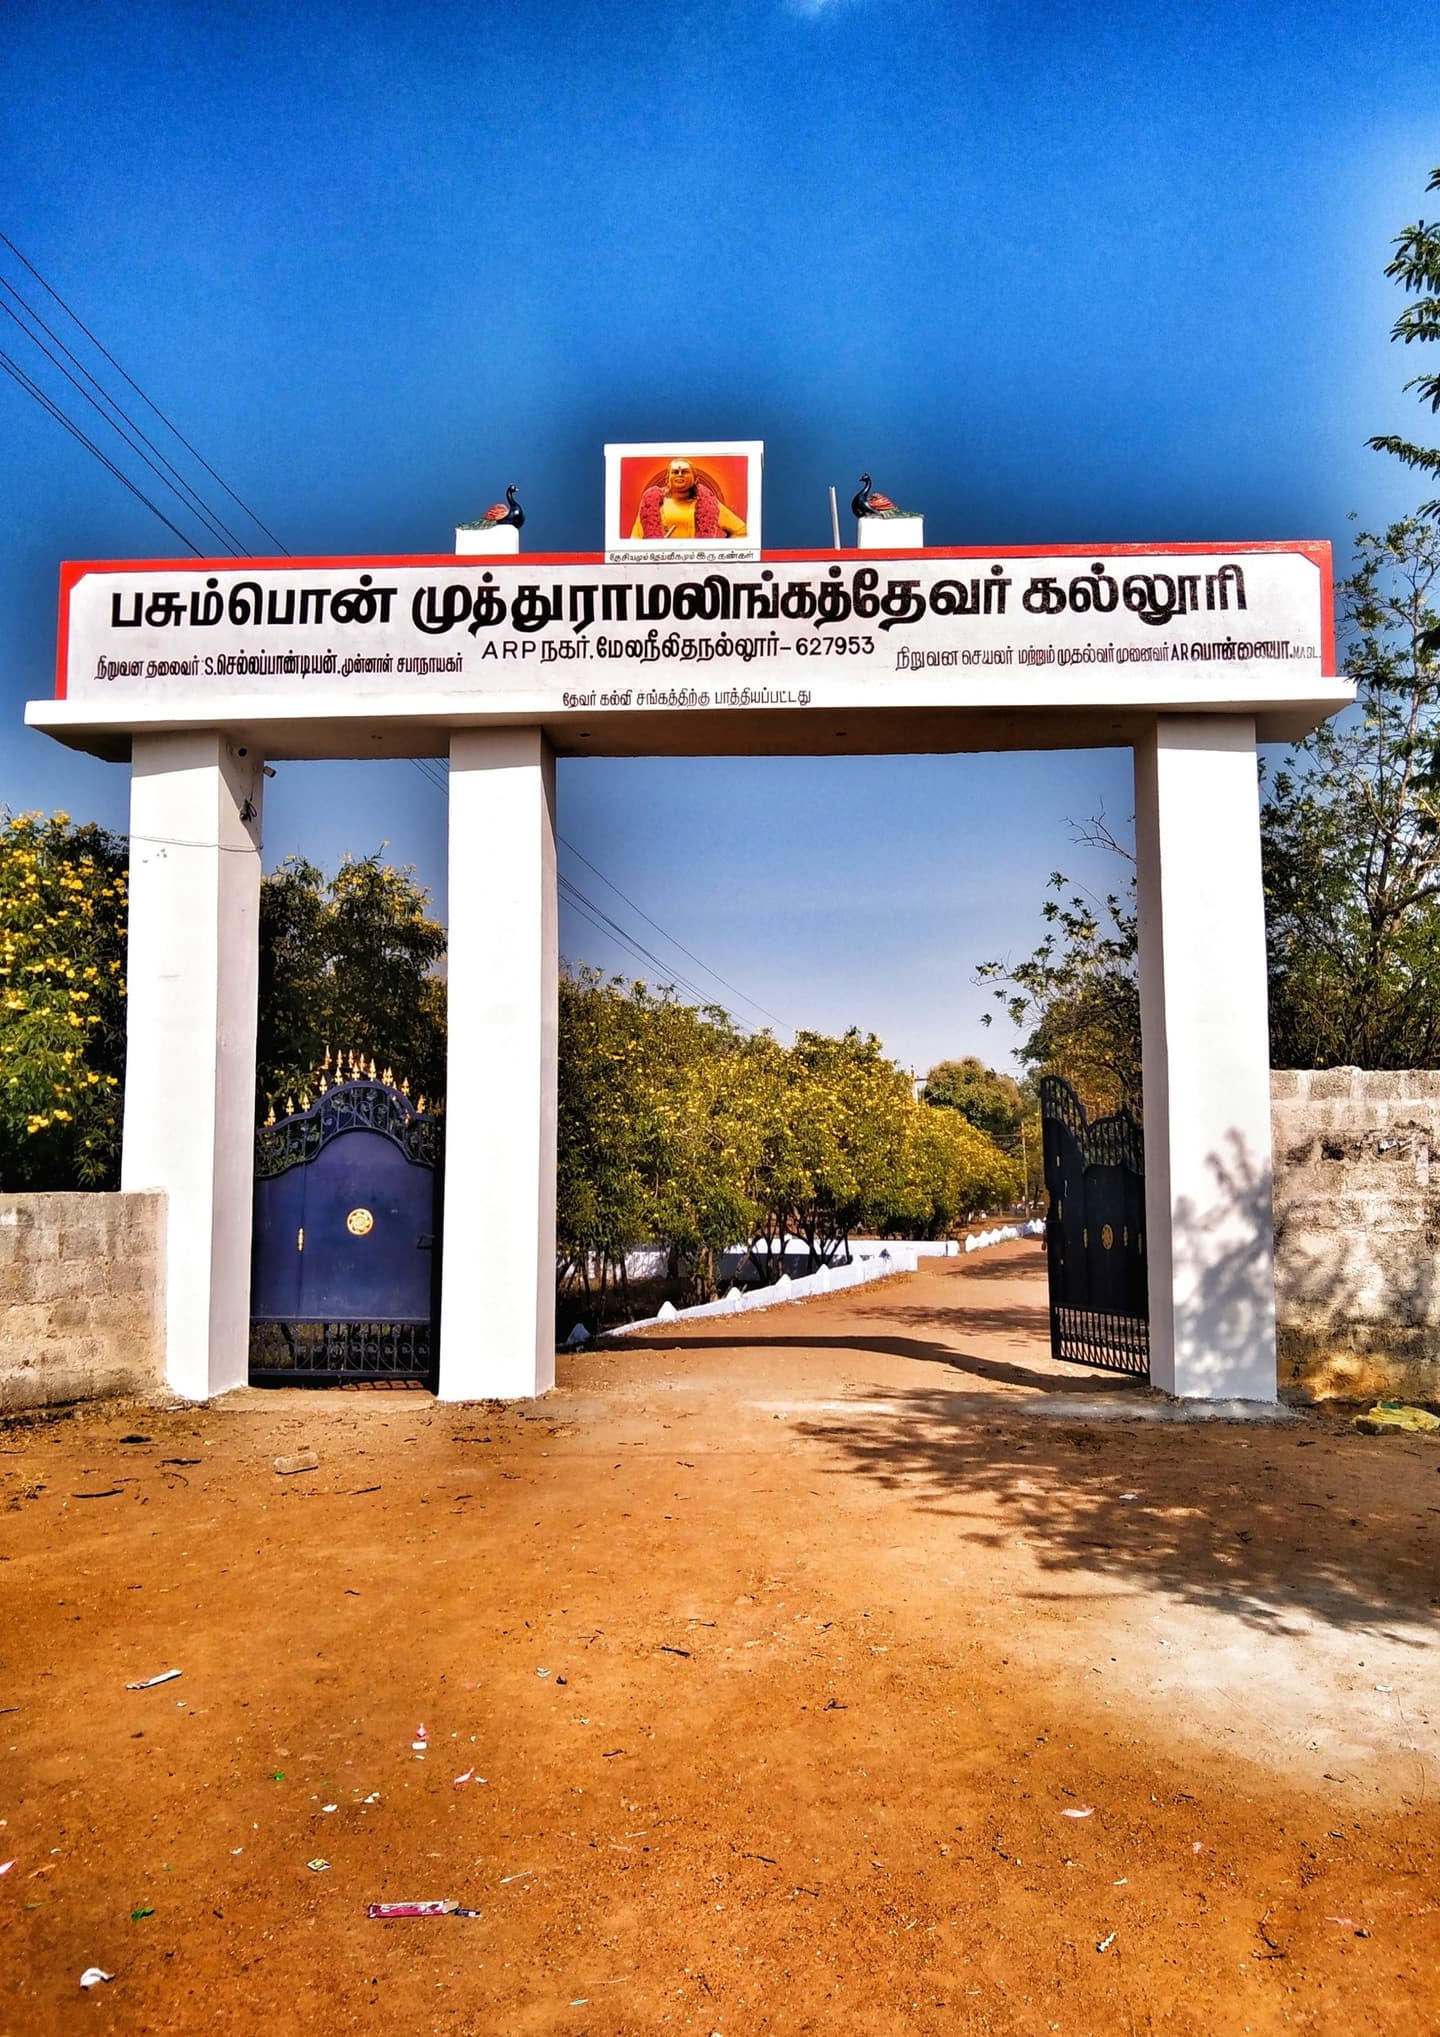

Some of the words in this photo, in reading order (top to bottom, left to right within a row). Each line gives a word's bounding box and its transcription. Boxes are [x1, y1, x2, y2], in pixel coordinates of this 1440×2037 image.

[111, 575, 397, 628] பசும்பொன்
[411, 563, 1010, 636] முத்துராமலிங்கத்தேவர்
[1023, 561, 1248, 625] கல்லூரி
[481, 641, 536, 659] ARP
[895, 646, 959, 671] நிறுவன
[962, 645, 1014, 665] செயலர்
[1018, 644, 1055, 666] மற்றும்
[1057, 643, 1114, 666] முதல்வர்
[94, 655, 144, 681] நிறுவன
[397, 652, 463, 675] சபாநாயகர்
[563, 690, 597, 709] தேவர்
[600, 690, 633, 706] கல்வி
[637, 688, 710, 708] சங்கத்திற்கு
[715, 687, 811, 707] பாத்தியப்பட்டது
